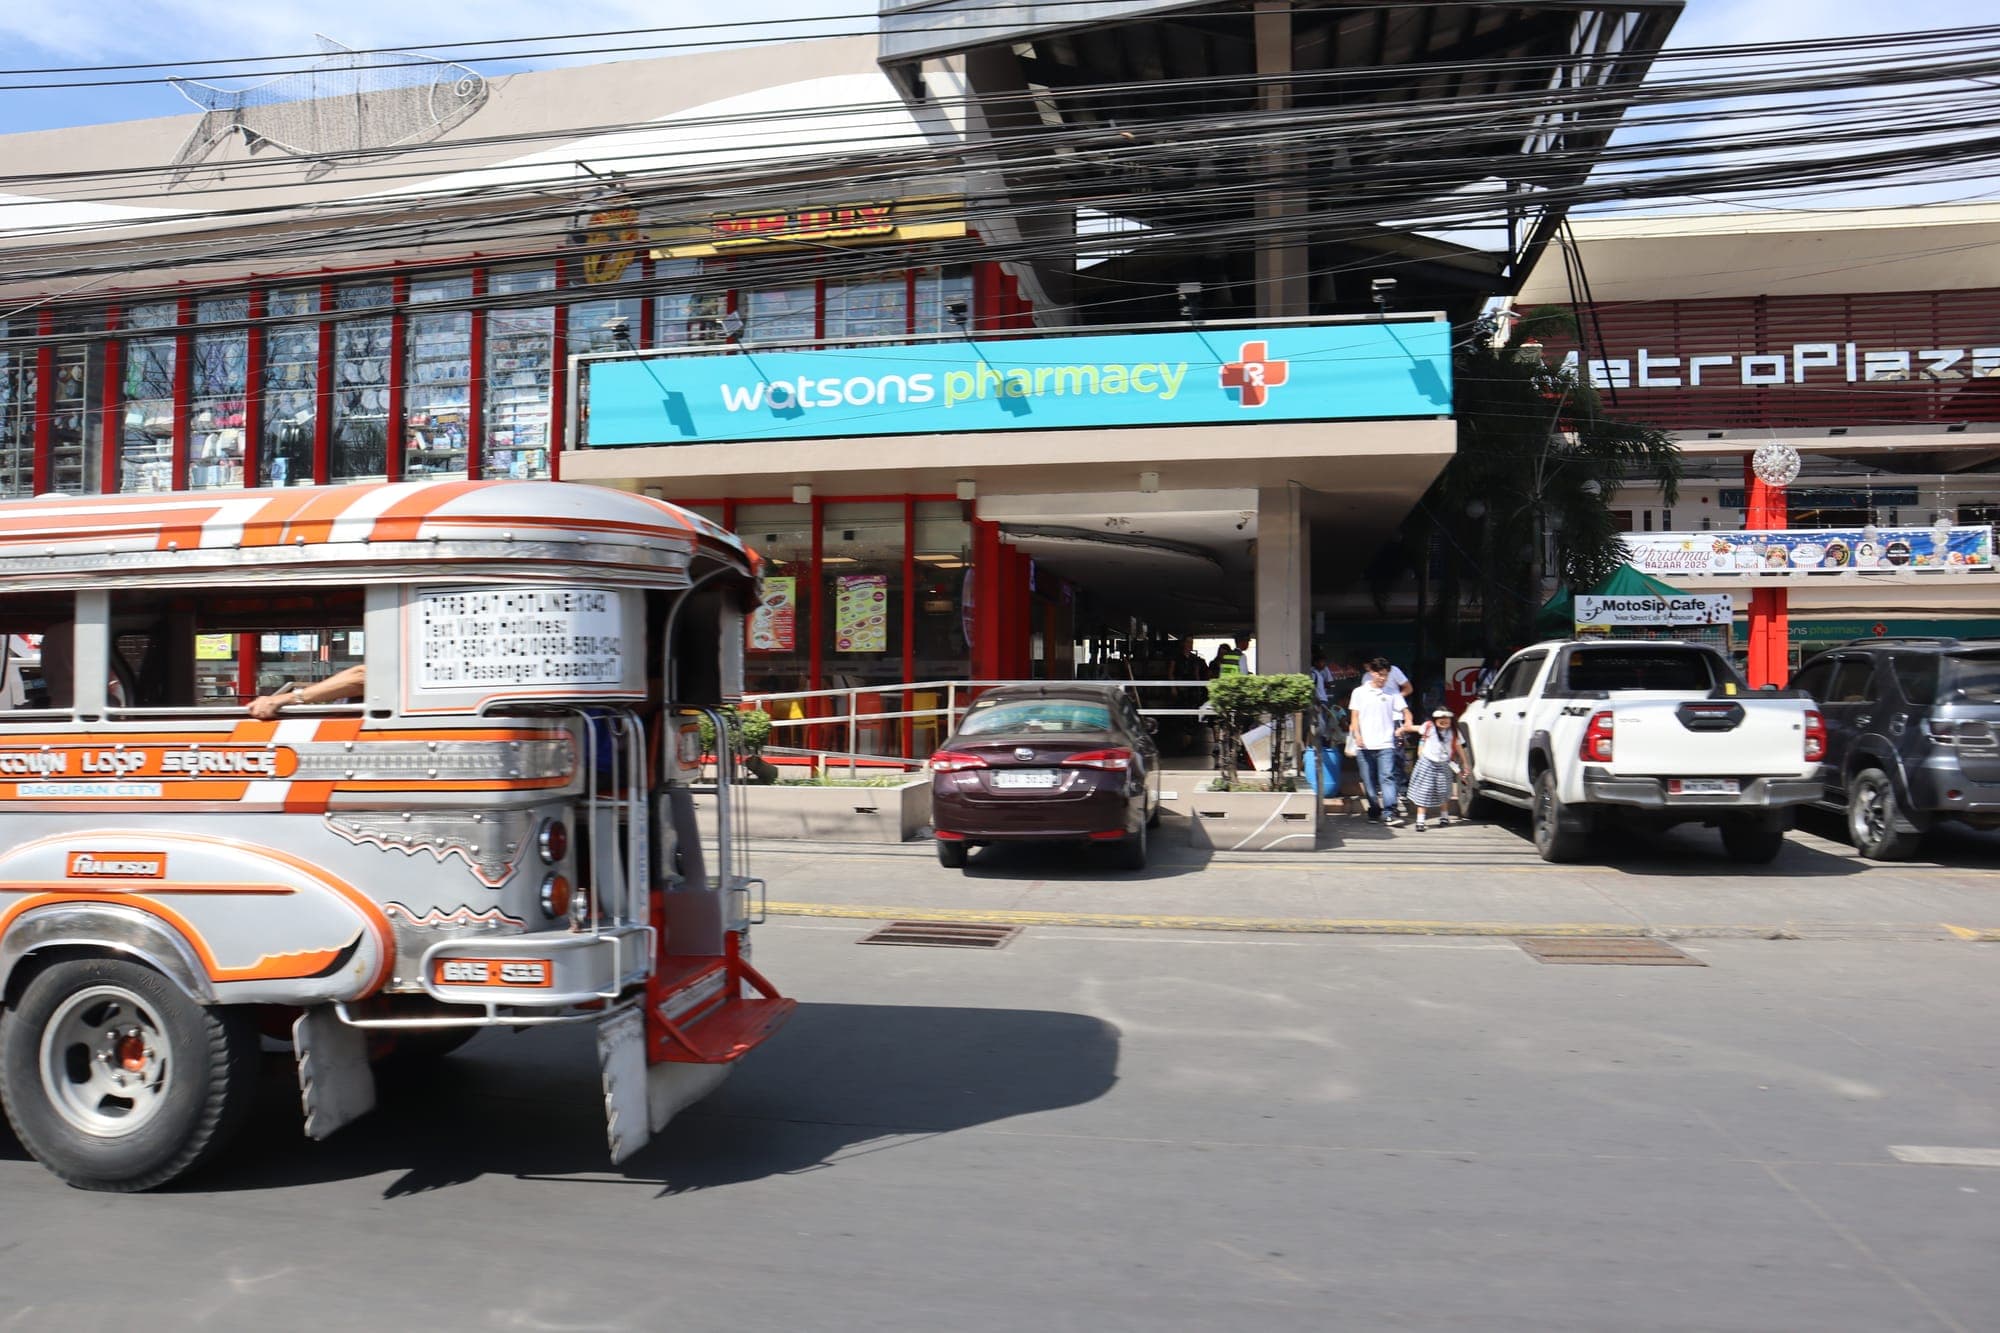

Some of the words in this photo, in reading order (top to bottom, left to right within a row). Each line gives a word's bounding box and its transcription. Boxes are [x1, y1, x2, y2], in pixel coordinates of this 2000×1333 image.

[720, 372, 934, 412] watsons
[944, 360, 1189, 408] pharmacy
[1632, 545, 1712, 565] Christmas
[1645, 561, 1681, 569] BAZAAR
[1684, 560, 1708, 569] 2025
[1602, 599, 1666, 614] MotoSip
[1670, 598, 1706, 611] Cafe
[83, 750, 147, 773] LOOP
[161, 750, 278, 773] SERVICE
[20, 784, 108, 795] DAGUPAN
[115, 784, 158, 795] CITY
